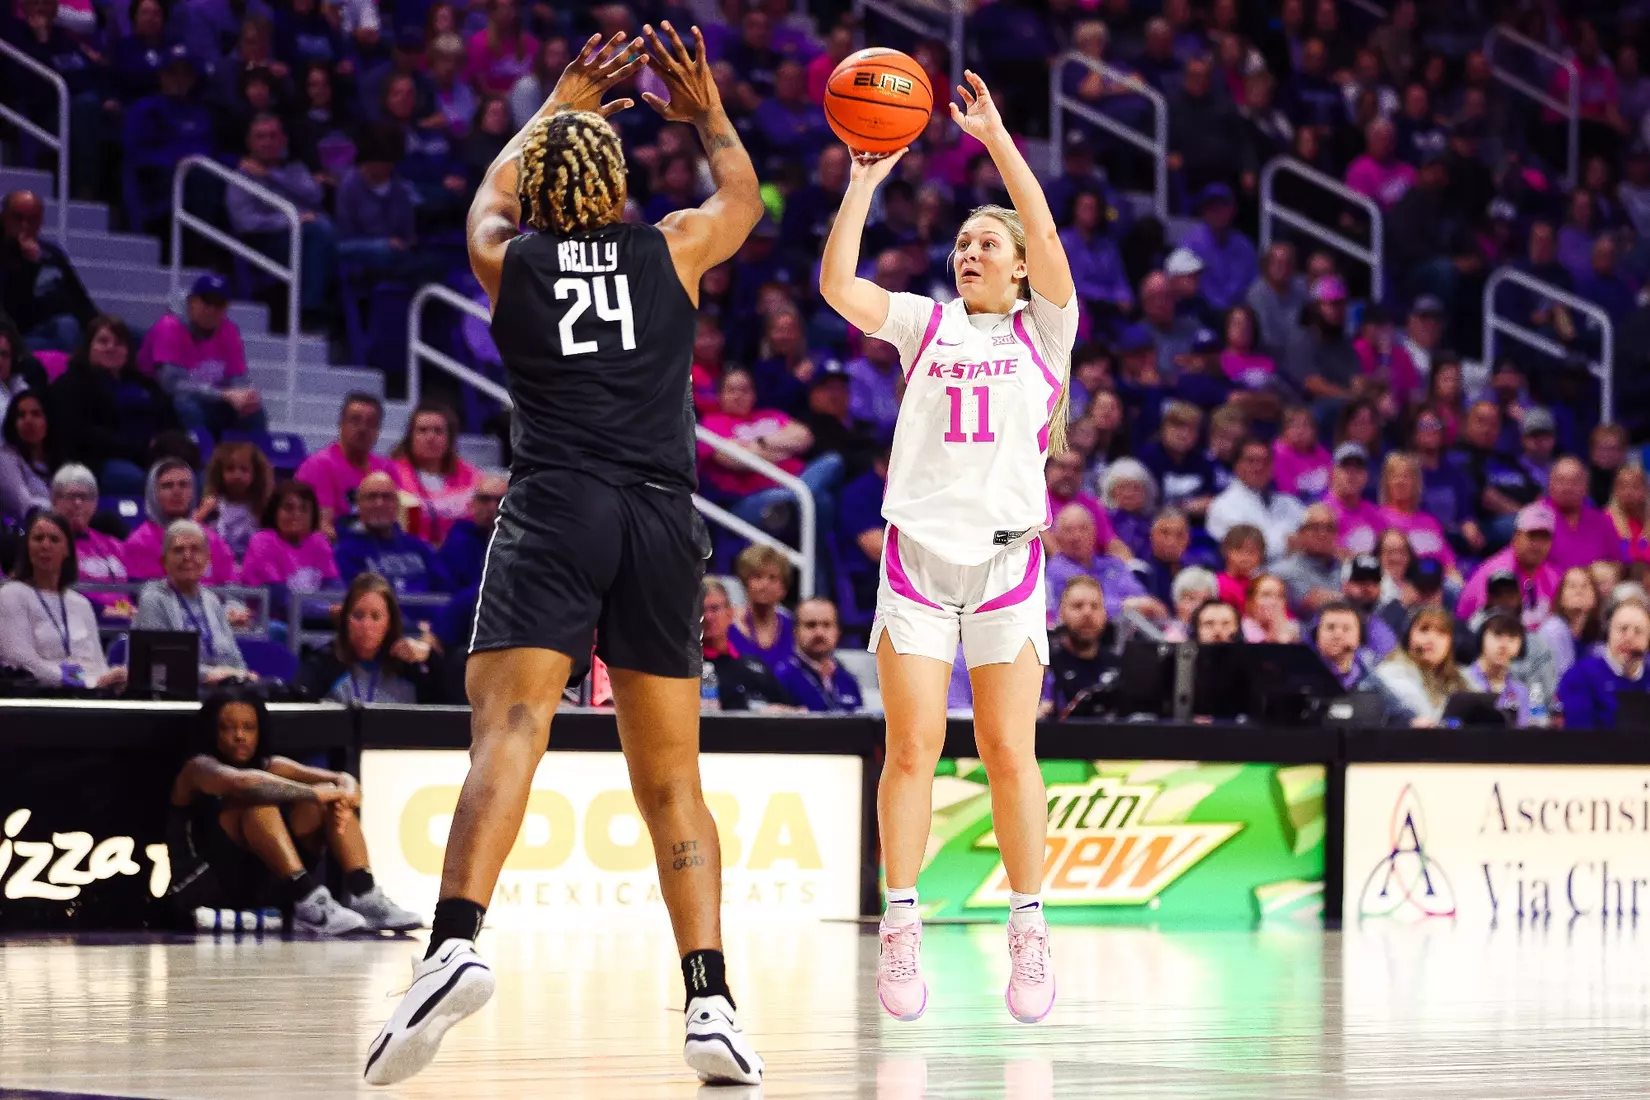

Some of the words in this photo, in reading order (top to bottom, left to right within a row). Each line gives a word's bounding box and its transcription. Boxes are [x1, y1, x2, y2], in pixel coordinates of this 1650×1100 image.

[557, 240, 618, 272] KELLY
[553, 274, 637, 356] 24
[927, 359, 1018, 380] K-STATE
[944, 386, 995, 442] 11
[497, 882, 662, 906] MEXICA
[1478, 861, 1552, 916] Via
